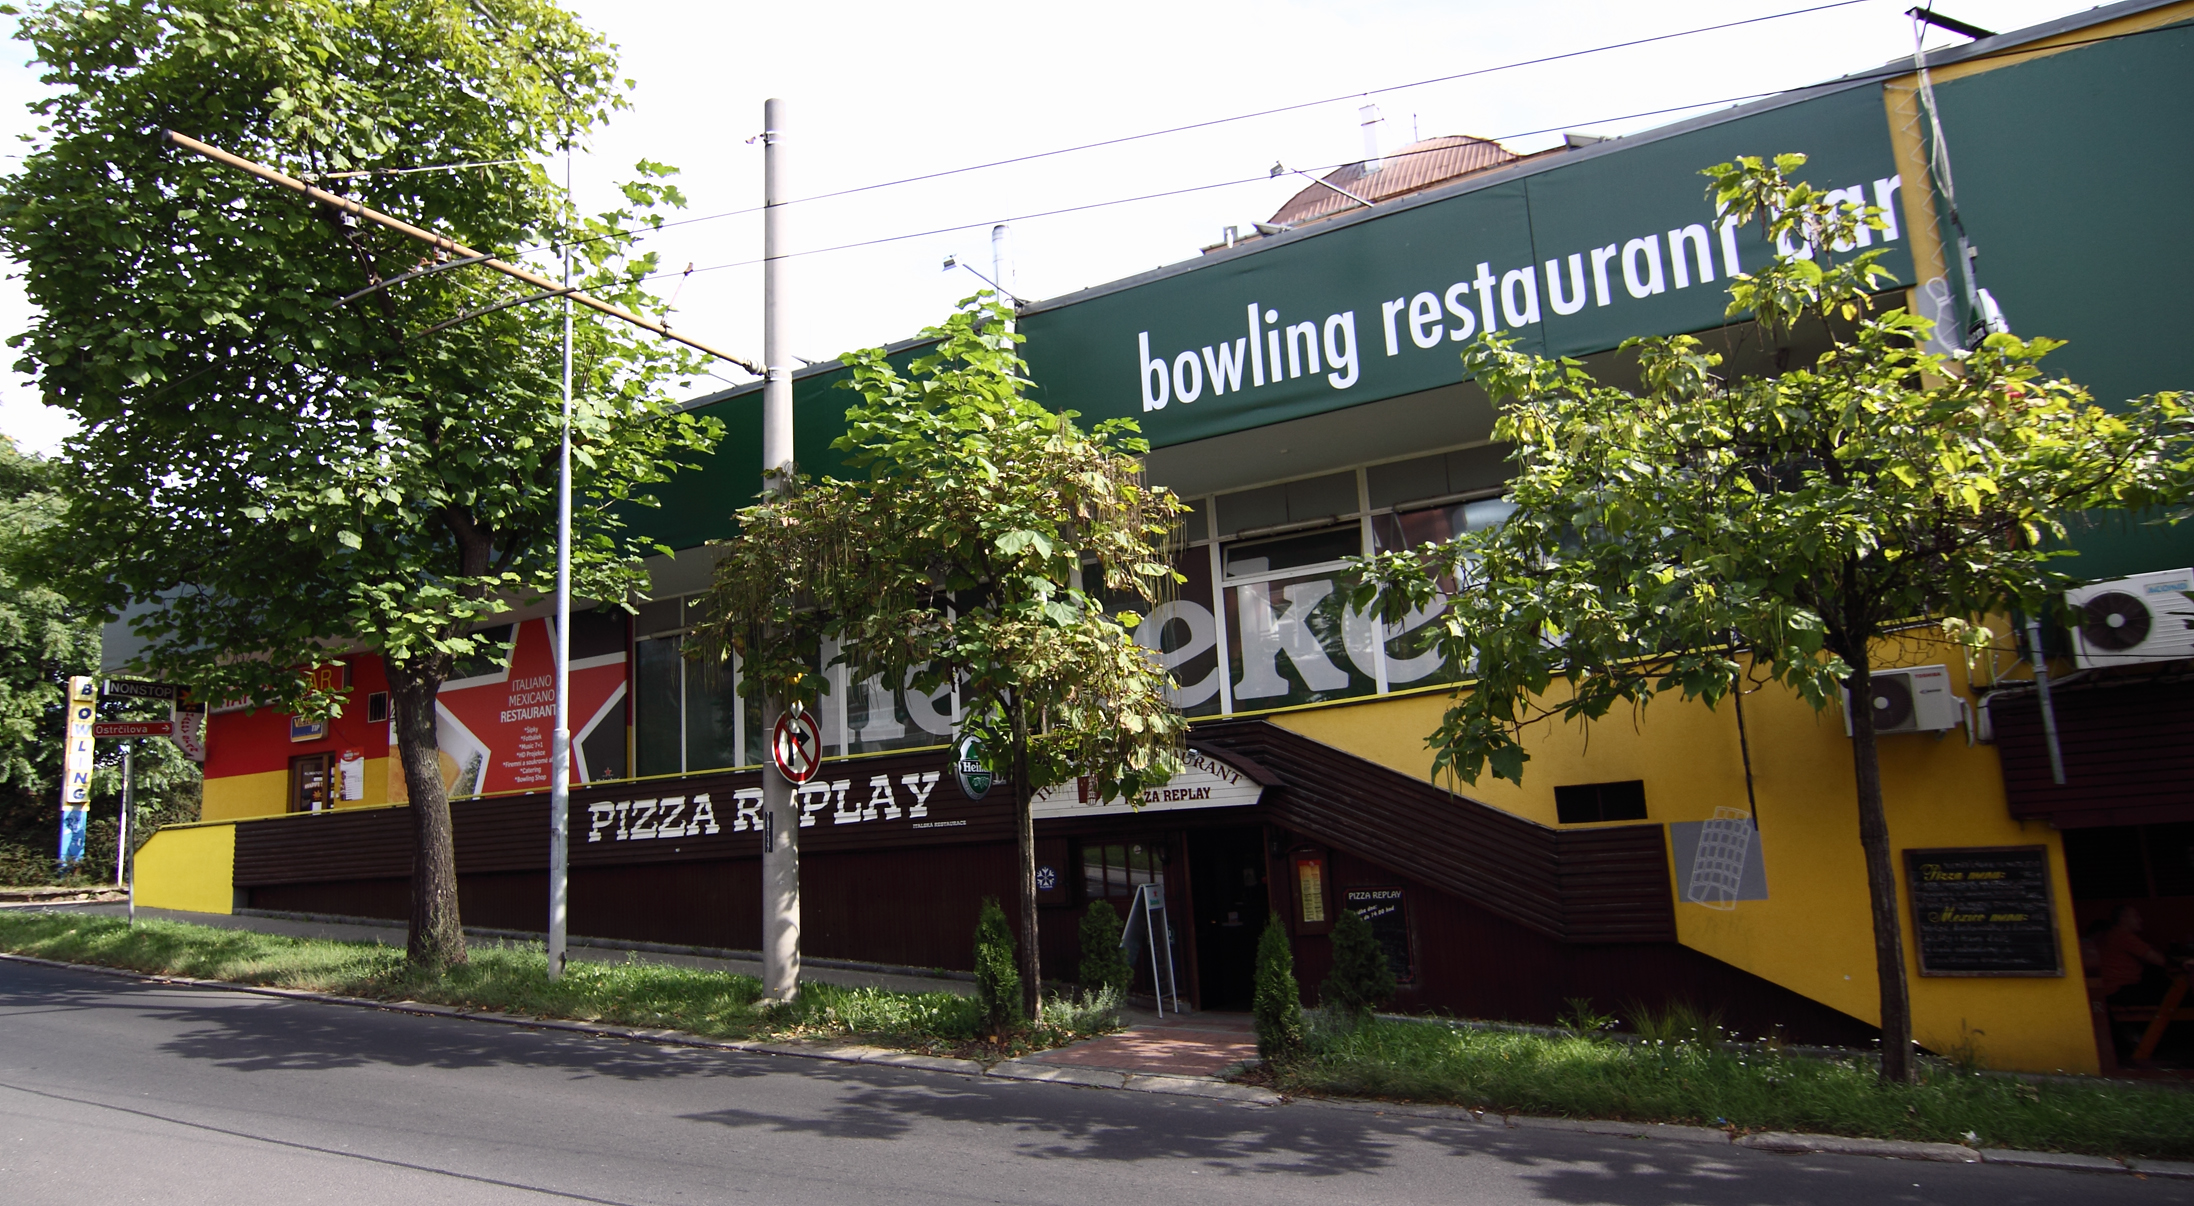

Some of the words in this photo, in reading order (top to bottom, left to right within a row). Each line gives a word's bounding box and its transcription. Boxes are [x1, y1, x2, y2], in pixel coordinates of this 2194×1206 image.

[1138, 302, 1360, 412] bowling
[1382, 199, 1742, 356] restaurant
[110, 682, 172, 697] NONSTOP
[512, 674, 552, 692] ITALIANO
[508, 689, 556, 707] MEXICANO
[500, 704, 557, 723] RESTAURANT
[96, 725, 148, 735] Ostrčilova
[73, 684, 94, 800] BOWLING
[1163, 786, 1211, 801] REPLAY
[588, 792, 721, 842] PIZZA
[733, 770, 940, 832] RPLAY
[1919, 863, 1964, 881] Pizza
[1348, 892, 1371, 900] PIZZA
[1372, 890, 1402, 899] REPLAY
